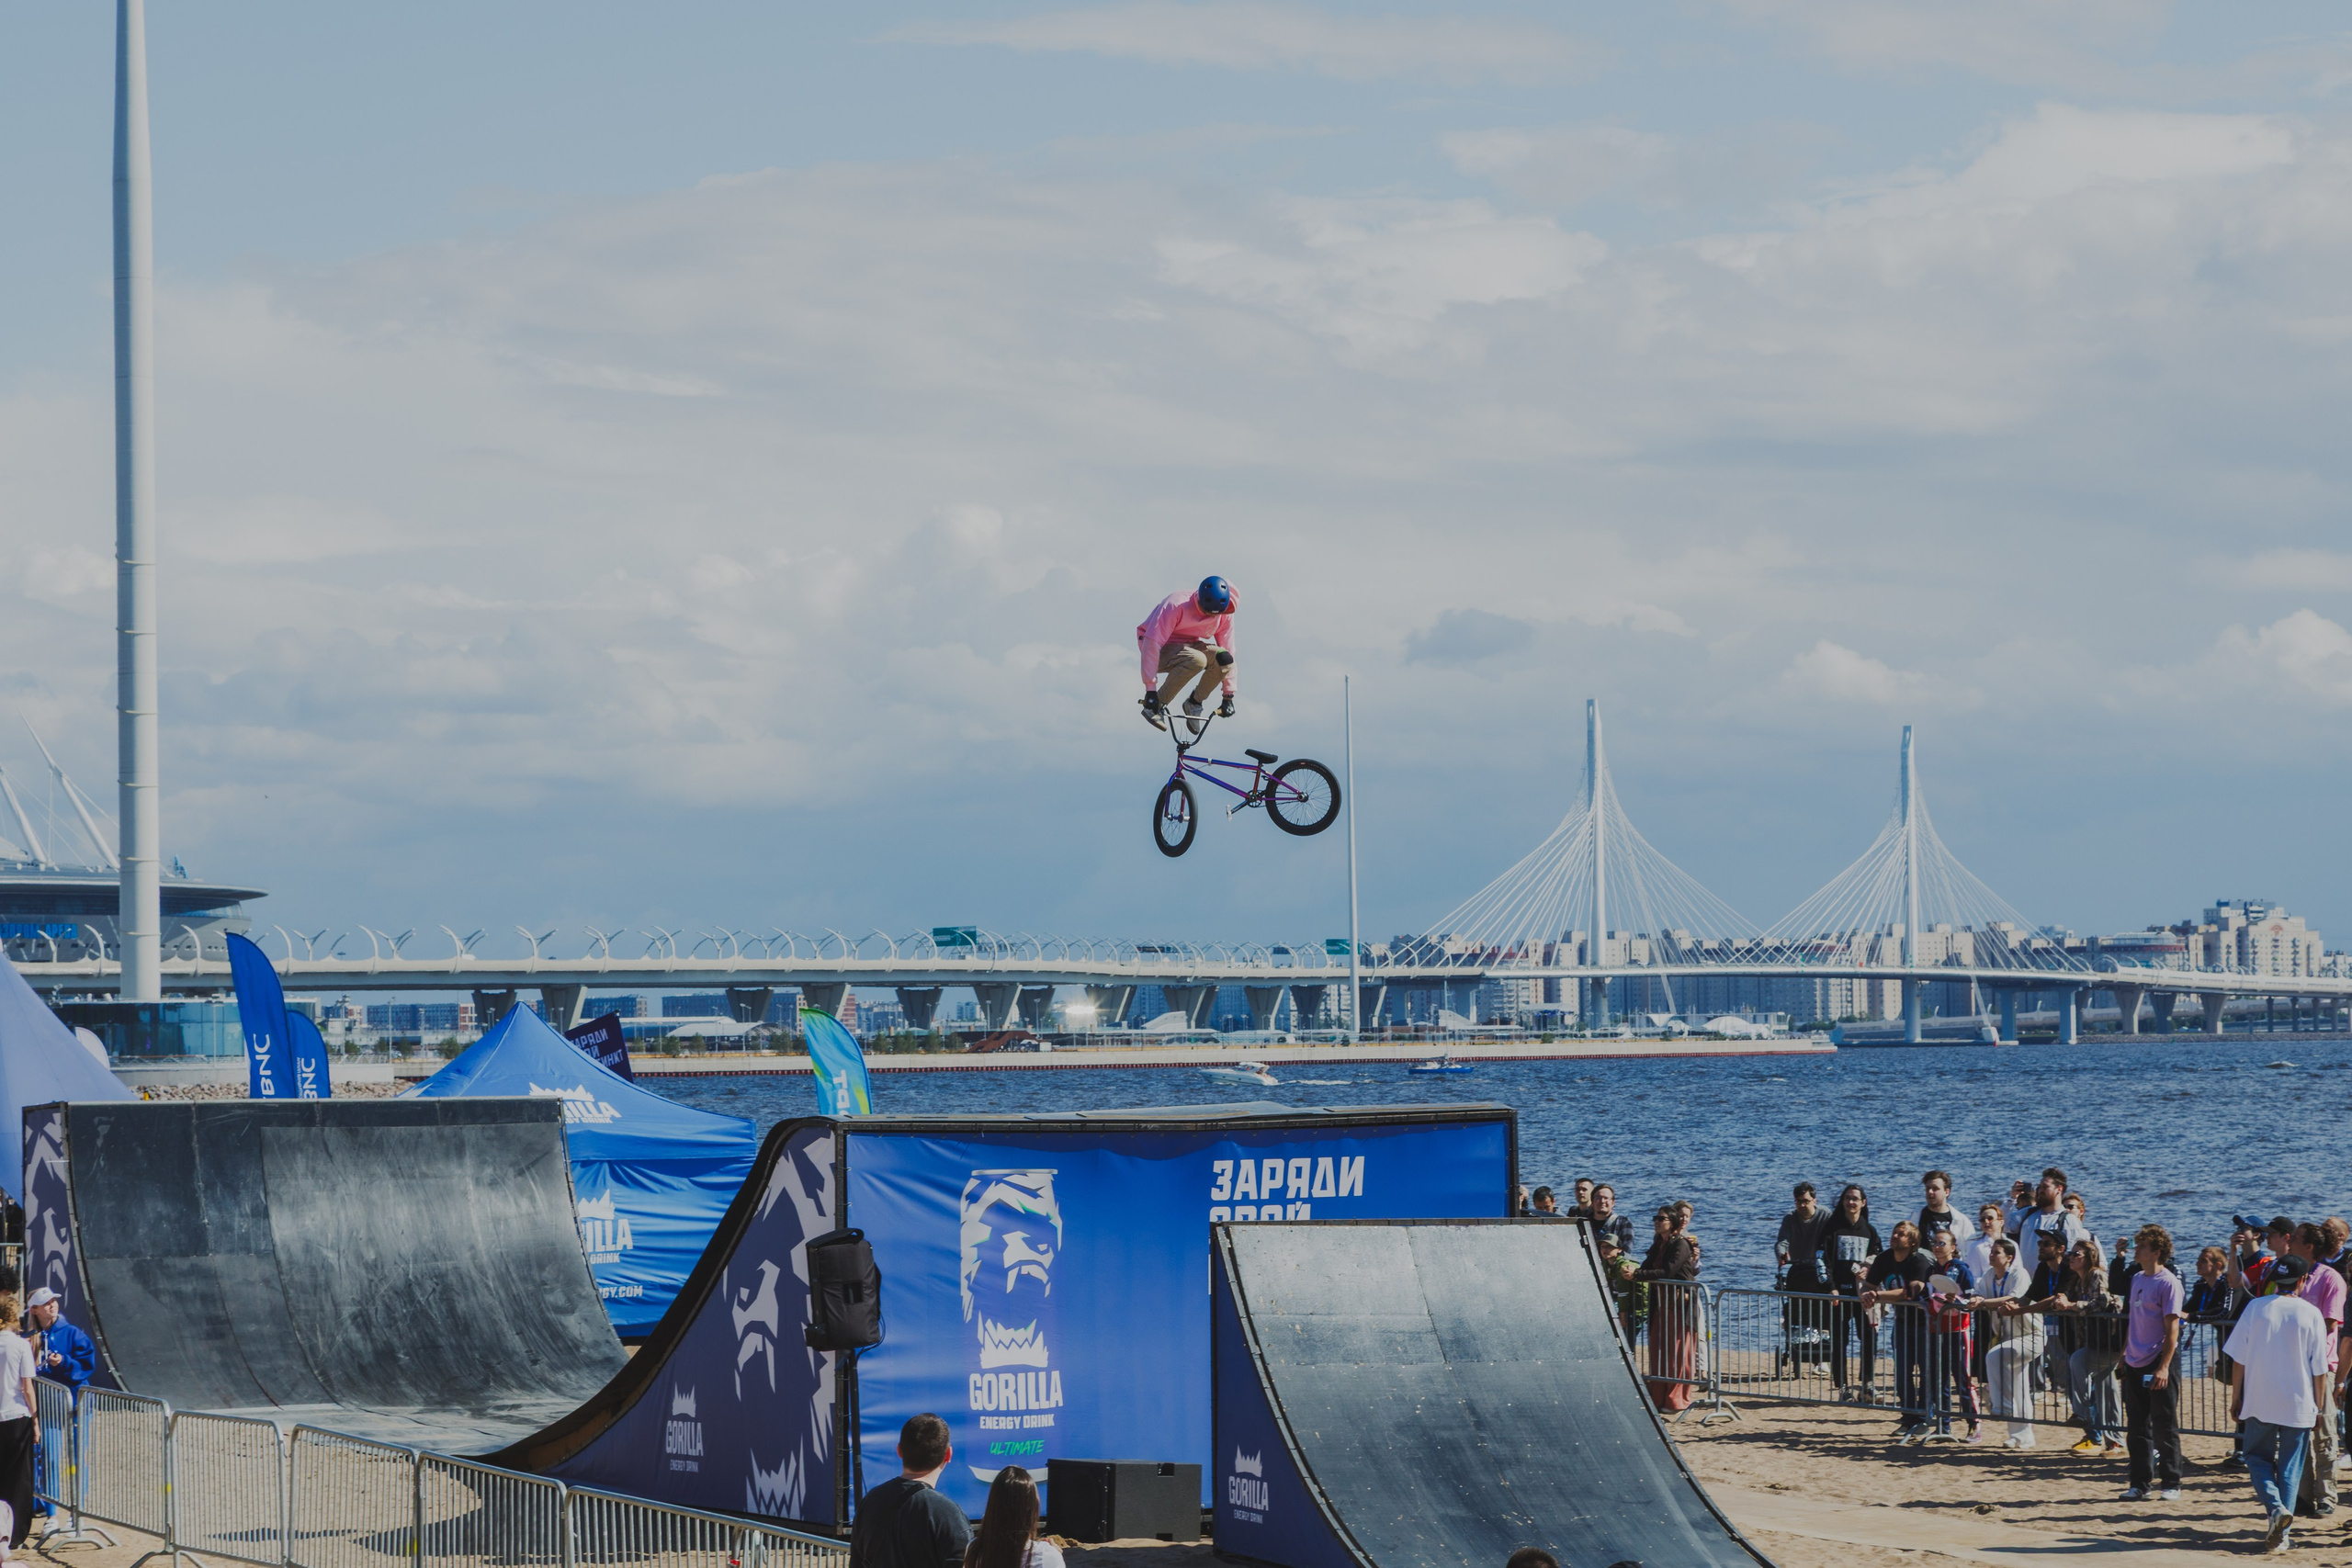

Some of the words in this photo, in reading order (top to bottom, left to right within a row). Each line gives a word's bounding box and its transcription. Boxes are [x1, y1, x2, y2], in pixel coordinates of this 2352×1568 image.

[563, 1101, 622, 1118] ILLA
[1210, 1156, 1365, 1201] ЗАРЯДИ
[581, 1219, 634, 1253] ILLA
[589, 1252, 621, 1265] DRINK
[598, 1285, 643, 1299] GY.COM
[969, 1371, 1064, 1411] GORILLA
[979, 1416, 1022, 1430] ENERGY
[1023, 1414, 1055, 1429] DRINK
[666, 1420, 704, 1456] GORILLA
[989, 1439, 1046, 1457] ULTIMATE
[1228, 1475, 1269, 1511] GORILLA
[1234, 1509, 1250, 1521] ENERGY
[1250, 1513, 1263, 1524] DRINK
